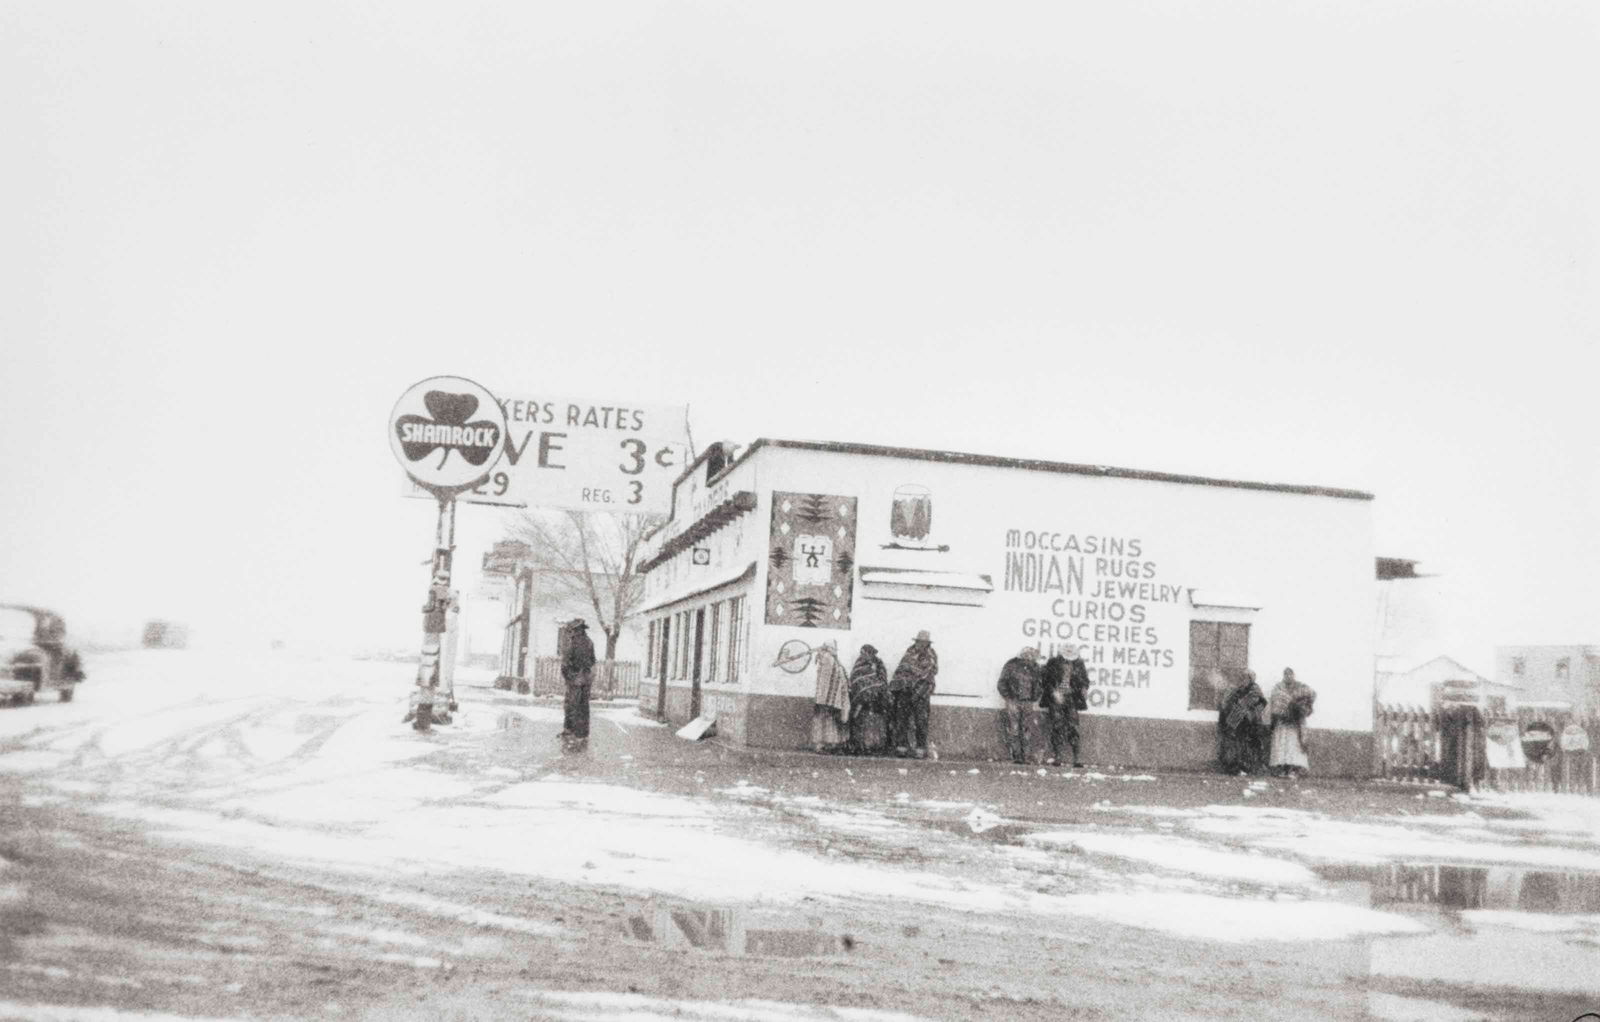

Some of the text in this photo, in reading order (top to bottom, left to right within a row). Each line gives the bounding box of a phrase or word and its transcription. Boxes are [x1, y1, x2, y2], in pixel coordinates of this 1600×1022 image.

[566, 404, 644, 431] RATES
[401, 422, 495, 447] SHAMROCK
[582, 487, 615, 504] REG.
[627, 480, 643, 505] 3
[1005, 529, 1142, 557] MOCCASINS
[1004, 551, 1156, 595] INDIAN RUGS
[1091, 580, 1182, 603] JEWELRY
[1051, 598, 1146, 623] CURIOS
[1022, 618, 1158, 645] GROCERIES
[1037, 641, 1174, 668] LCH MEATS
[1089, 667, 1150, 688] CREAM
